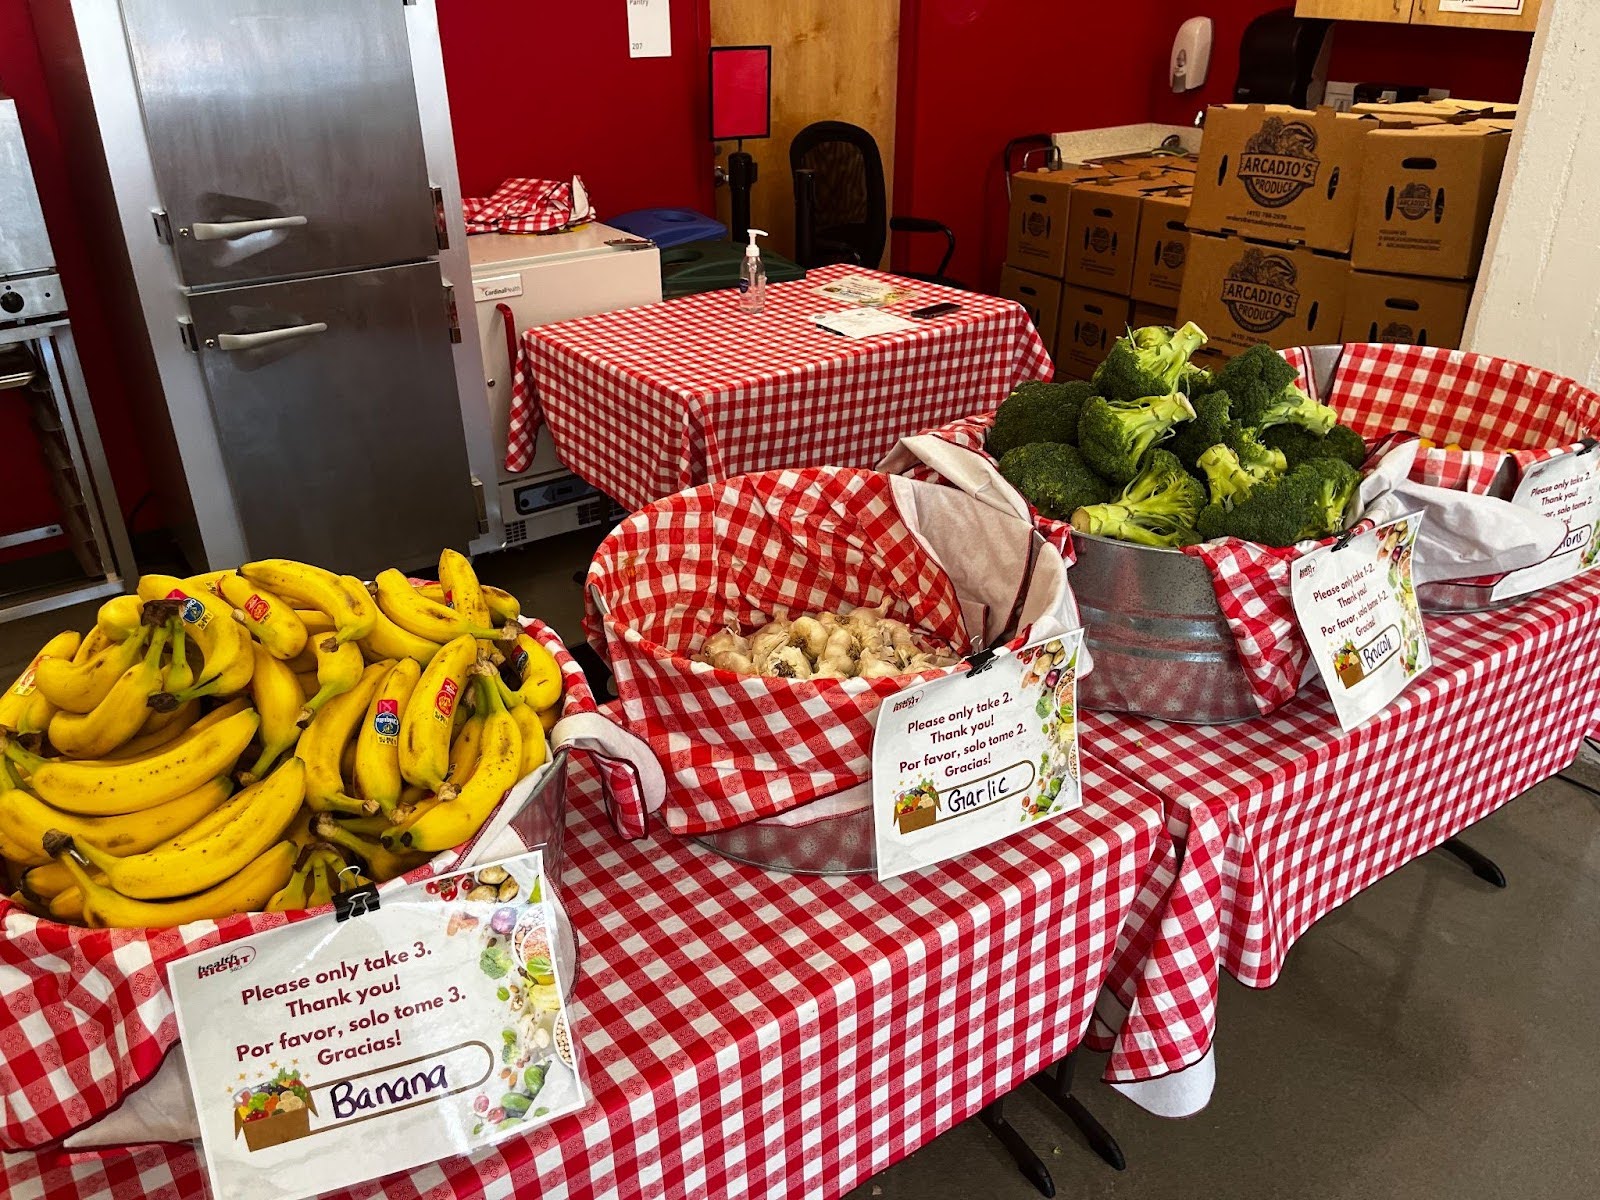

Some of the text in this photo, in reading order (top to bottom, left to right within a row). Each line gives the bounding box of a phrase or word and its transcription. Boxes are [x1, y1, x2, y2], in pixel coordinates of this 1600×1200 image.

[1243, 157, 1313, 178] ARCADIO'S
[1255, 178, 1293, 194] PRODUCE
[1227, 283, 1294, 309] ARCADIO'S
[1238, 303, 1276, 321] PRODUCE
[1530, 485, 1552, 497] Please
[1553, 479, 1569, 491] only
[1570, 474, 1584, 486] take
[1541, 487, 1579, 506] Thank you!
[1557, 504, 1571, 515] solo
[1572, 500, 1587, 511] tome
[1313, 585, 1341, 603] Please
[1341, 576, 1353, 589] only
[1352, 569, 1364, 582] take
[1337, 582, 1368, 608] Thank you!
[1320, 624, 1336, 637] Por
[1336, 614, 1359, 630] favor,
[1358, 604, 1368, 618] solo
[1366, 598, 1379, 611] tome
[1355, 615, 1376, 637] Gracias!
[1363, 633, 1393, 670] Broccoli
[907, 691, 1014, 735] Please only take 2.
[930, 714, 995, 745] Thank you!
[899, 722, 1028, 774] Por favor, solo tome 2.
[944, 752, 992, 778] Gracias!
[947, 776, 1010, 814] Garlic
[198, 954, 238, 972] health
[198, 954, 251, 979] RIGHT
[241, 939, 432, 1006] Please only take 3.
[285, 975, 402, 1020] Thank you!
[235, 985, 467, 1062] Por favor, solo tome 3.
[316, 1030, 403, 1067] Gracias!
[329, 1064, 449, 1120] Banana
